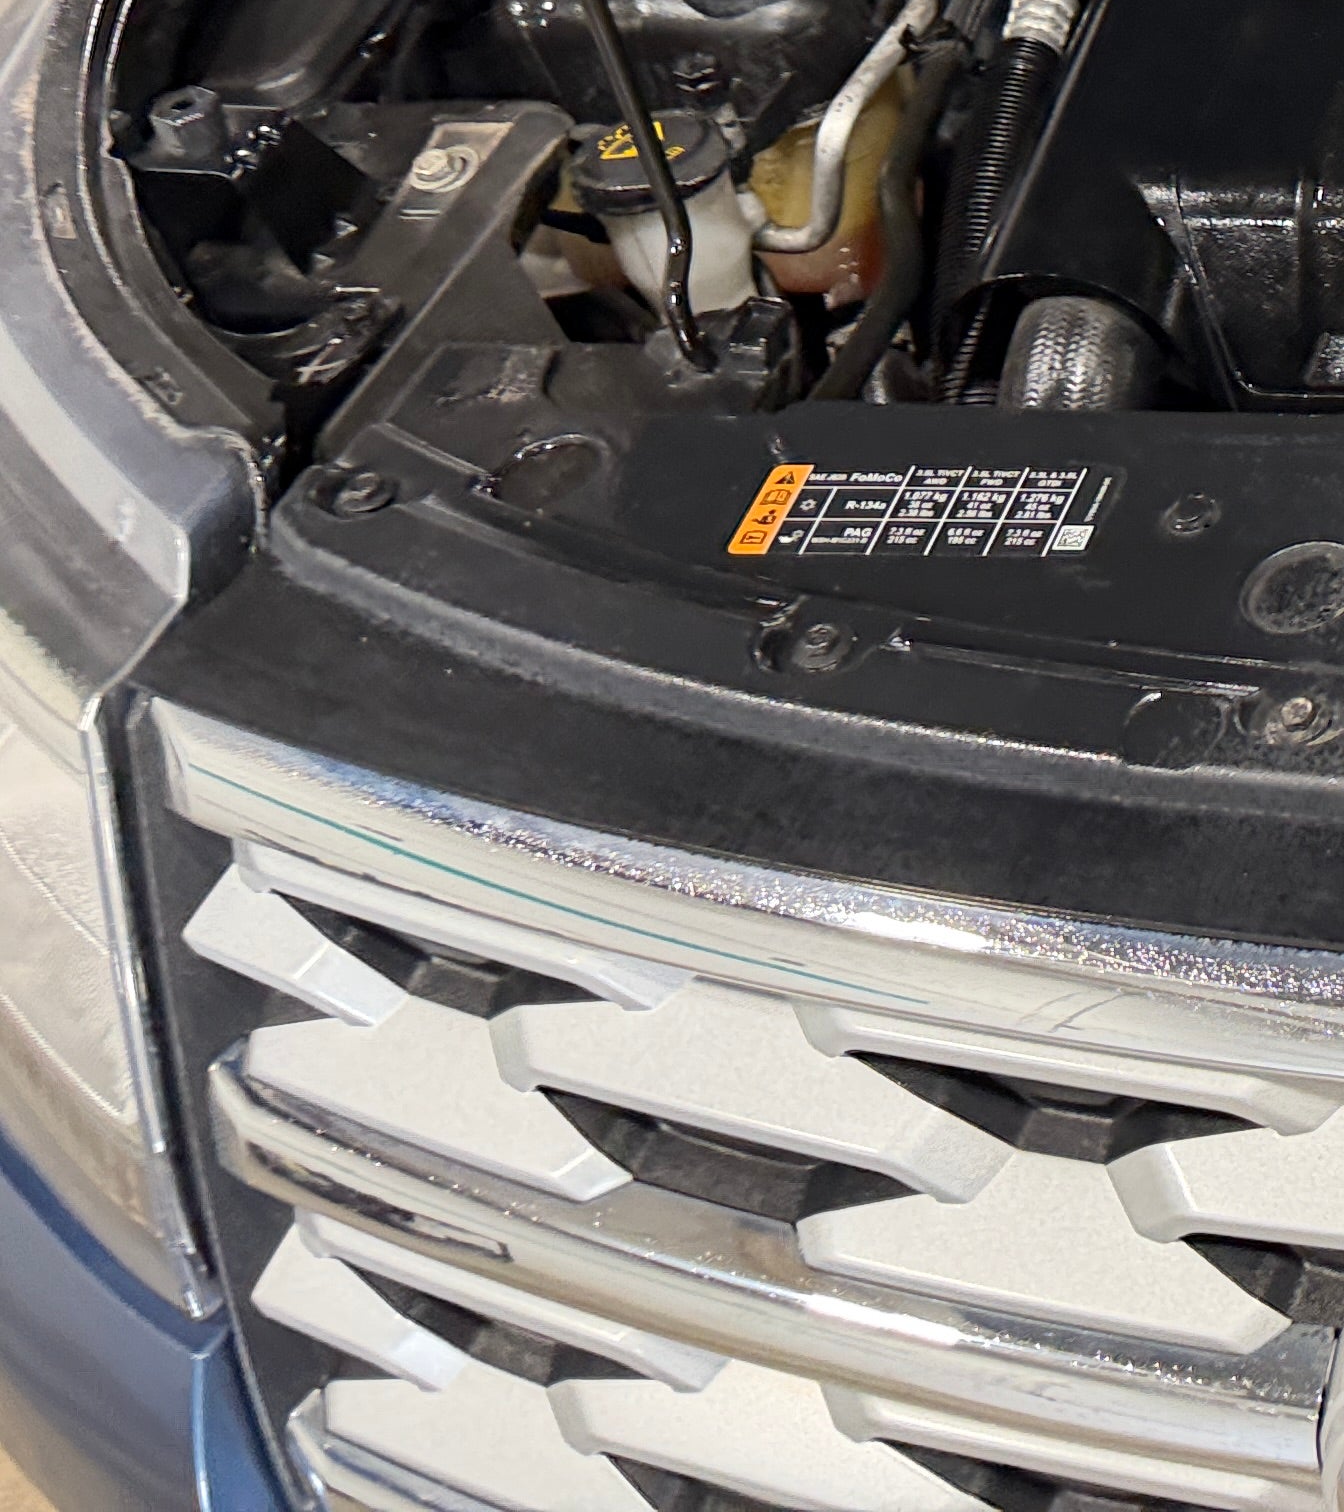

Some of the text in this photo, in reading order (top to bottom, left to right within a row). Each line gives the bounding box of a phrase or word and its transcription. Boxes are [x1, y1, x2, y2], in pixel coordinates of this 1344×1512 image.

[849, 472, 904, 483] FoMoCo
[933, 491, 949, 502] kg
[991, 492, 1007, 503] kg
[1049, 494, 1066, 505] kg
[844, 500, 887, 510] R-134a
[844, 527, 873, 537] PAG
